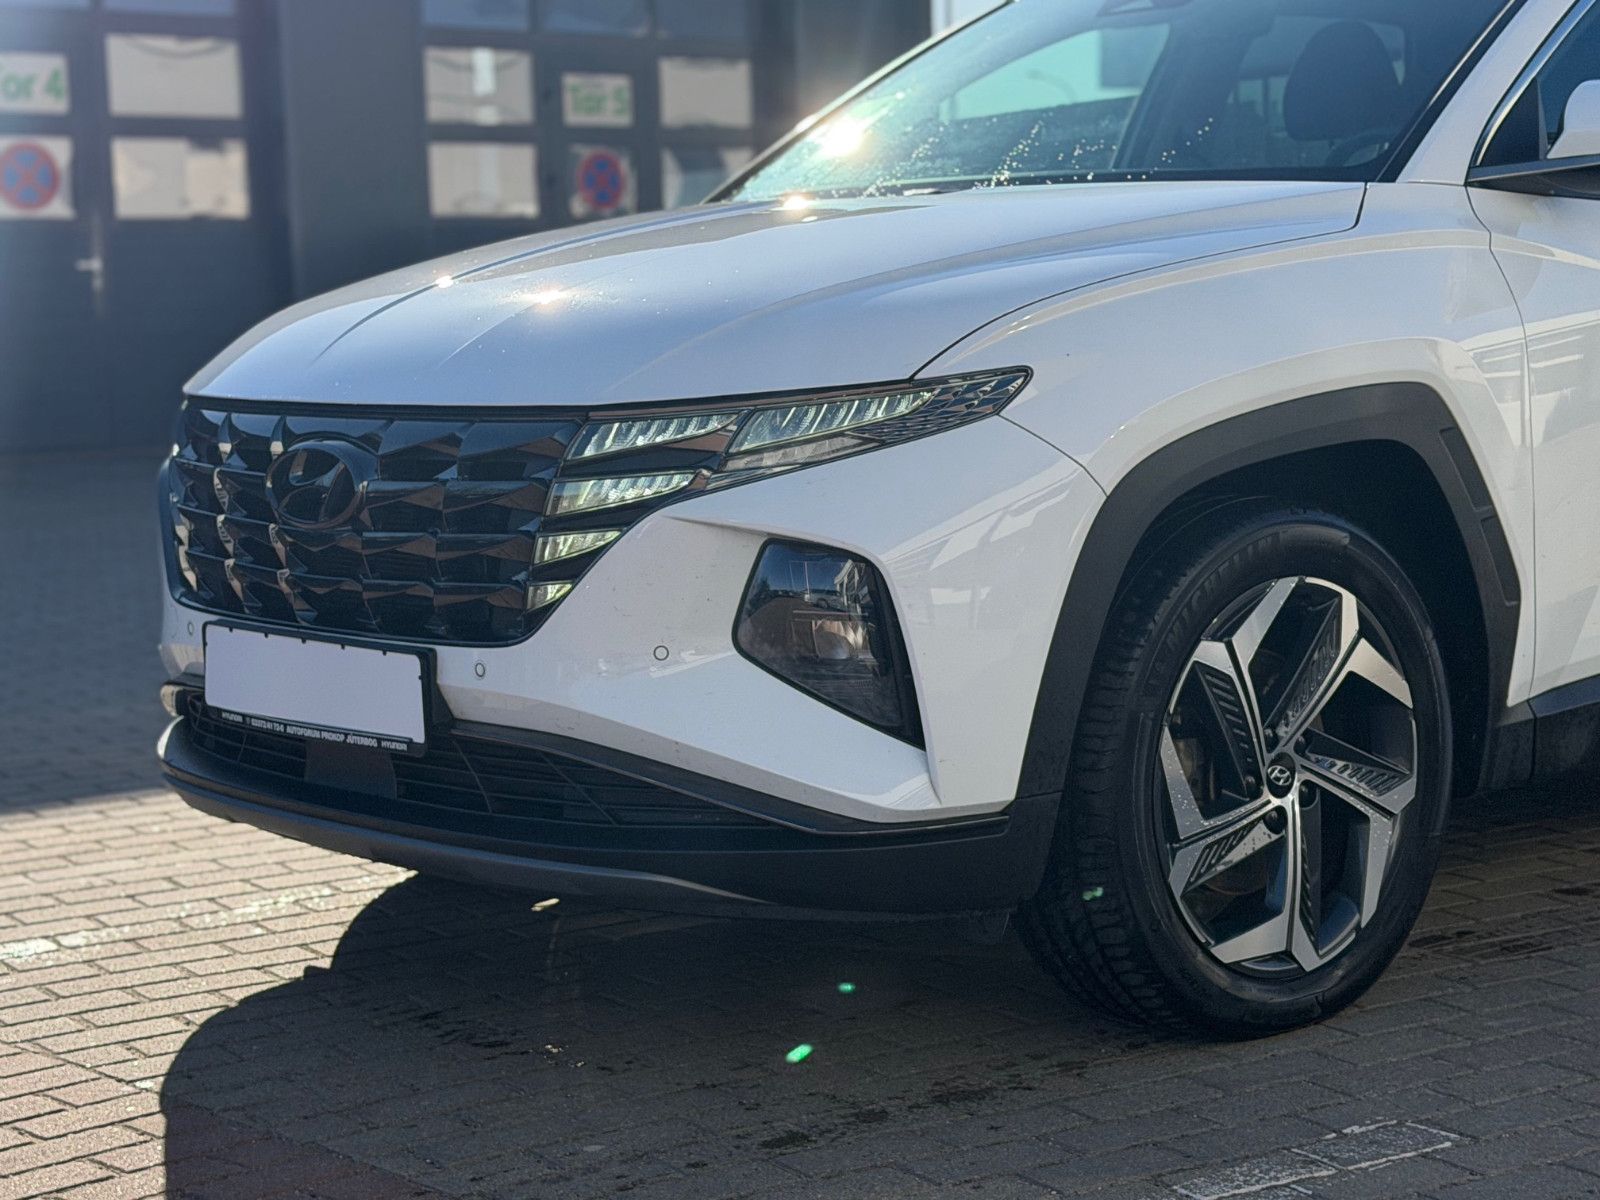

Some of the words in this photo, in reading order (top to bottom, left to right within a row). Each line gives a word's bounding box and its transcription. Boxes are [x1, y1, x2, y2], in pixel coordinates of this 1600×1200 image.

[0, 64, 38, 101] or
[43, 66, 66, 101] 4
[286, 725, 321, 739] AUTOFORUM
[321, 731, 345, 742] PROKOP
[381, 741, 408, 752] HYUNDAI
